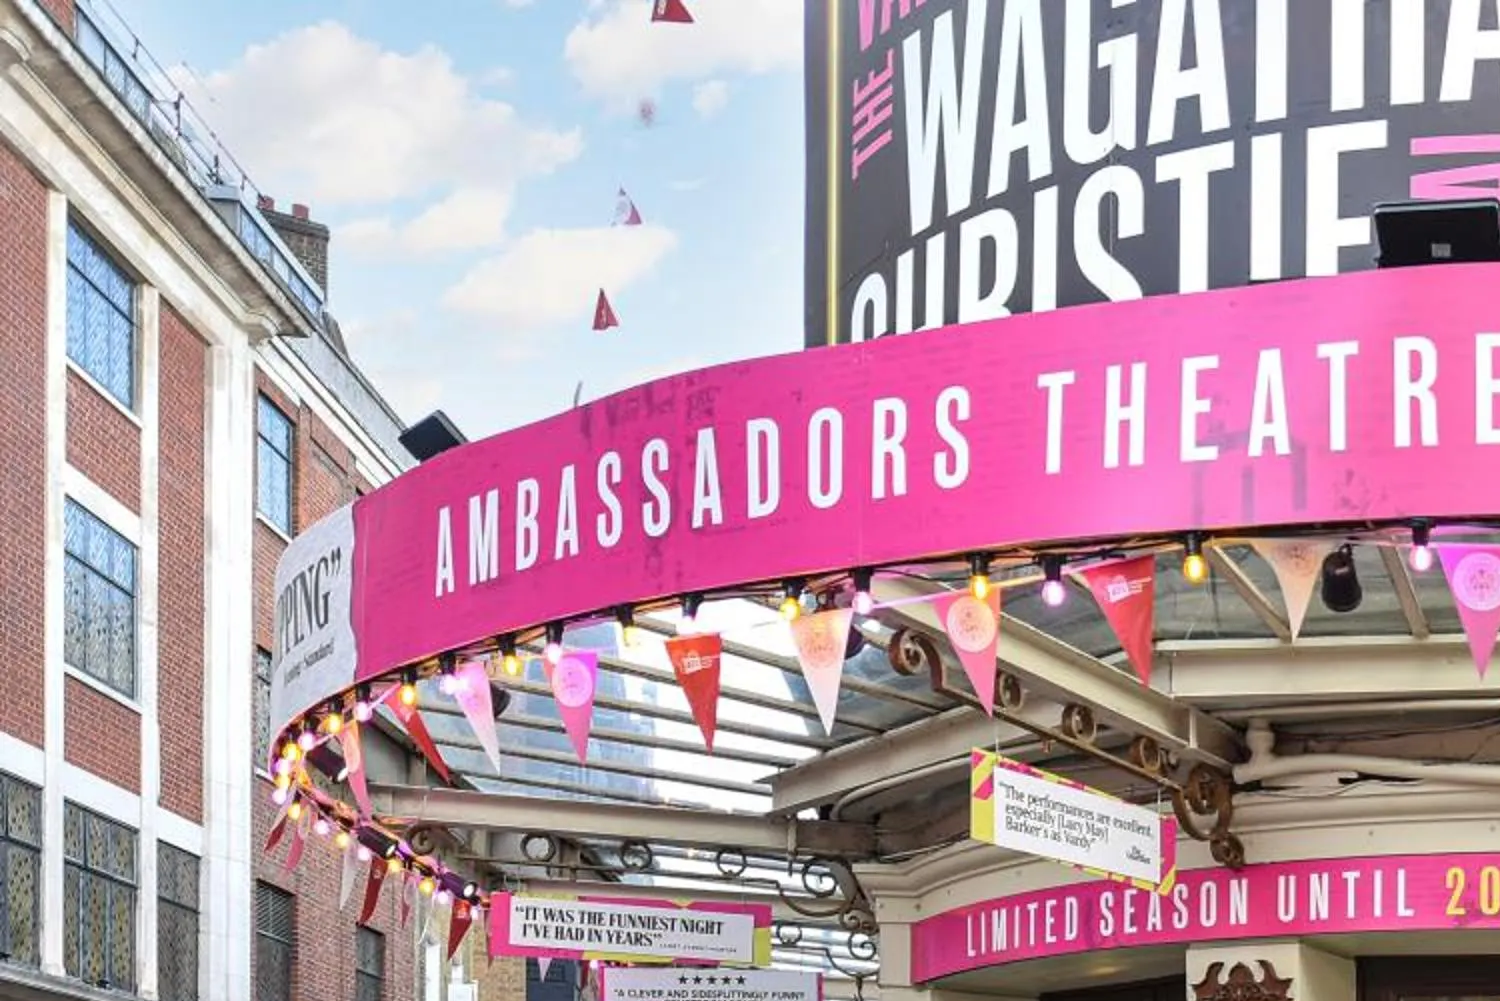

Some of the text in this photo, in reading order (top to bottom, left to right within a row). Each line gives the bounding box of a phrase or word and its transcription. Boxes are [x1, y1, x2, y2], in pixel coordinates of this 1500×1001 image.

[852, 47, 894, 181] THE
[434, 385, 971, 599] AMBASSADORS
[1005, 803, 1056, 828] especially
[1027, 794, 1095, 821] performances
[1096, 813, 1111, 827] are
[1050, 829, 1061, 842] as
[543, 908, 575, 924] WAS
[578, 910, 604, 926] THE
[608, 912, 679, 932] FUNNIEST
[679, 918, 726, 936] NIGHT
[966, 896, 1079, 957] LIMITED
[1099, 877, 1250, 938] SEASON
[1276, 867, 1415, 923] UNTIL
[1445, 866, 1500, 916] 20
[554, 925, 585, 941] HAD
[586, 927, 605, 943] IN
[627, 989, 663, 998] CLEVER
[667, 990, 689, 998] AND
[771, 991, 805, 1000] FUNNY
